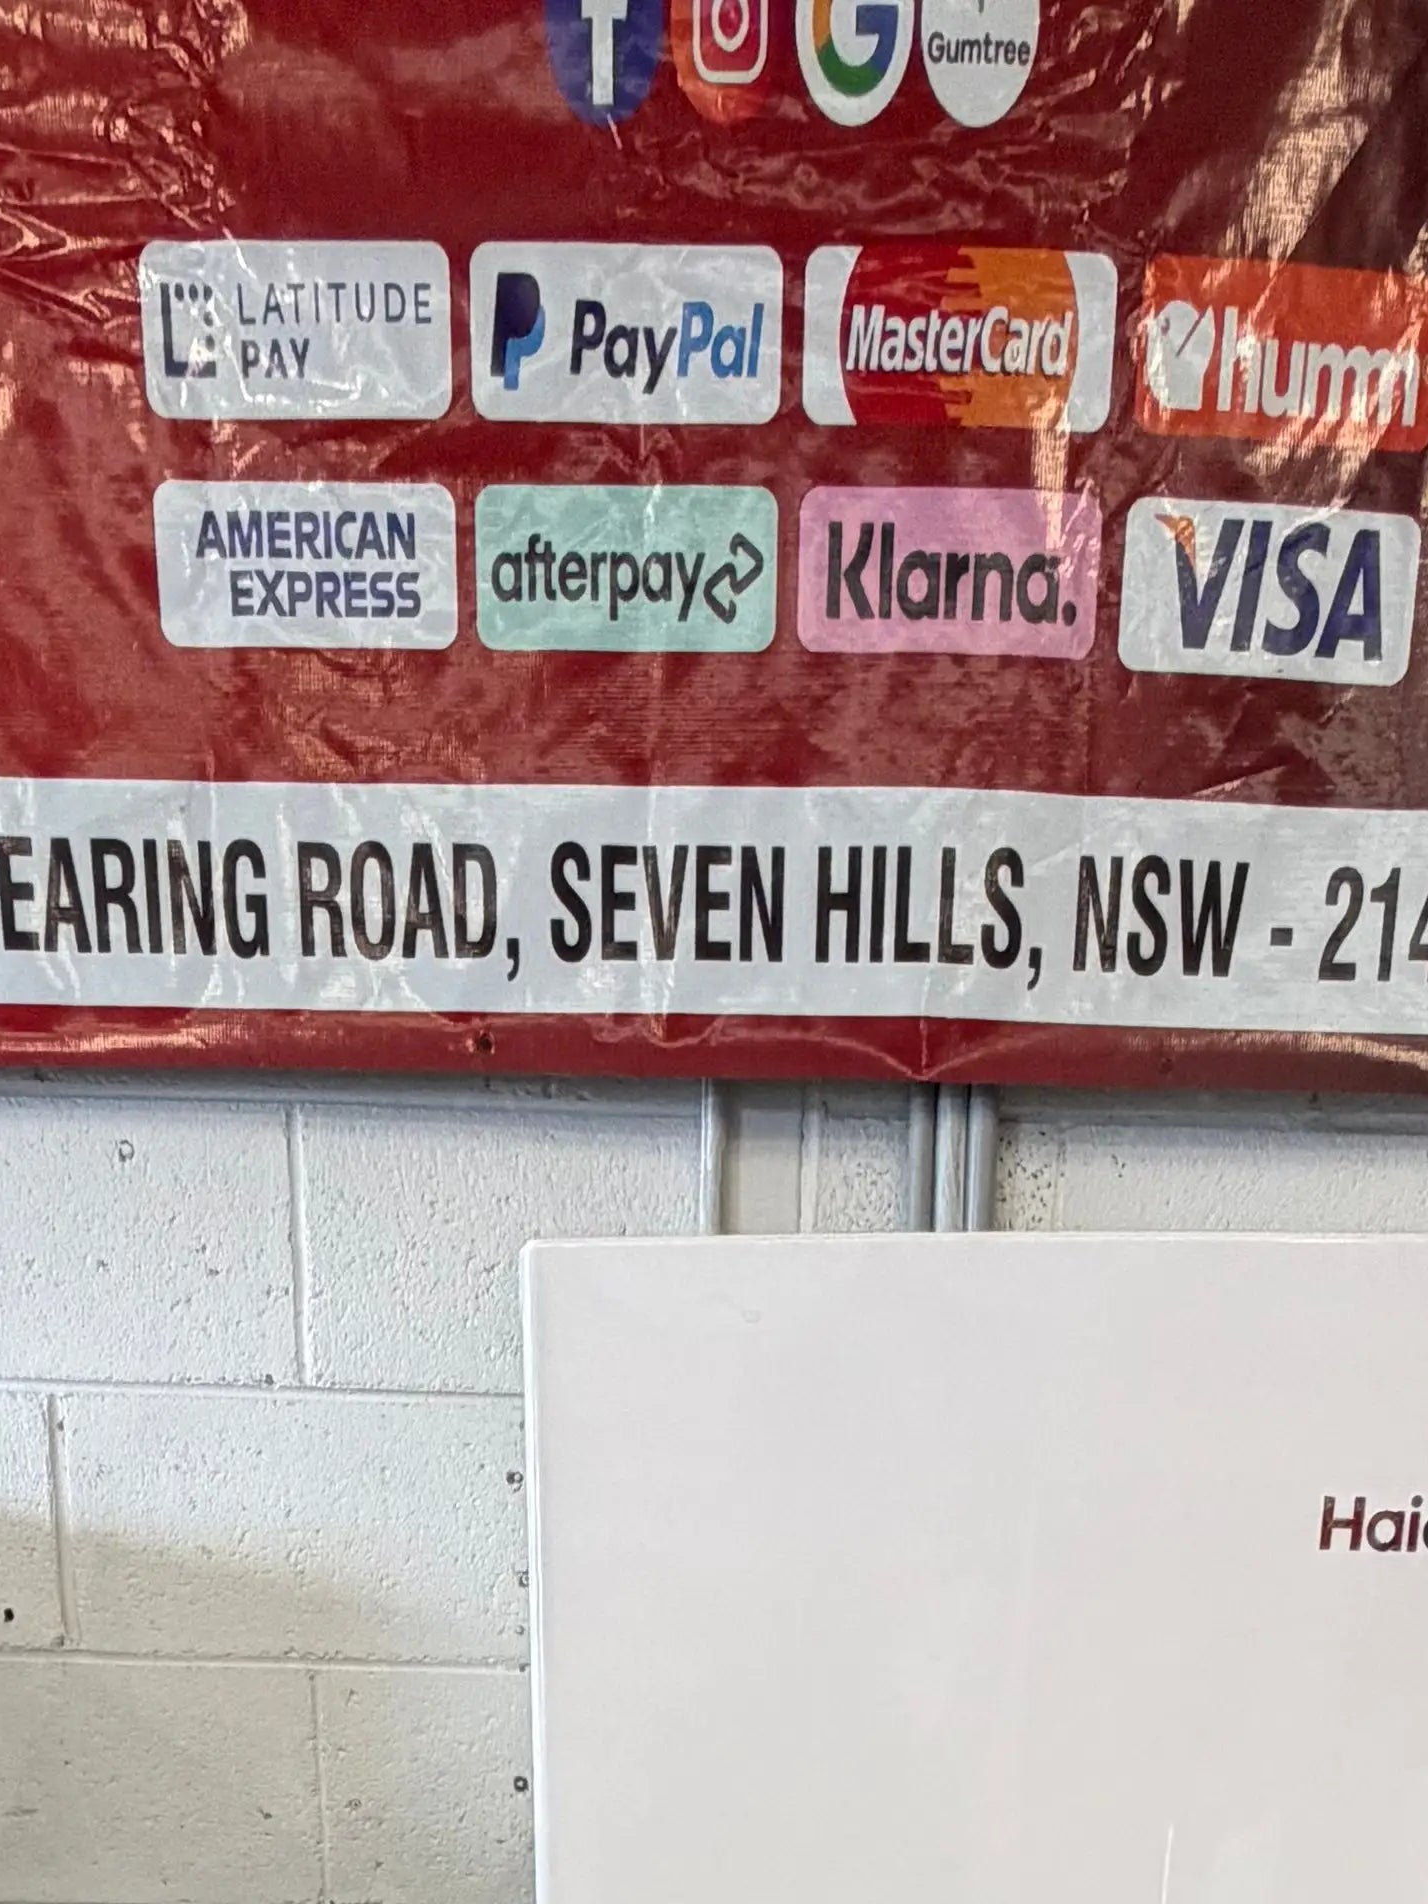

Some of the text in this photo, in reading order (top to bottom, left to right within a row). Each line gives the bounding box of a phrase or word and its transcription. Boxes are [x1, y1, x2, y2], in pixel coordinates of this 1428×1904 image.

[927, 31, 1031, 65] Gumtree
[236, 279, 433, 326] LATITUDE
[843, 302, 1073, 376] MasterCard
[241, 337, 310, 379] PAY
[572, 299, 761, 394] PayPal
[1216, 304, 1420, 428] humm
[195, 510, 417, 560] AMERICAN
[230, 569, 422, 618] EXPRESS
[491, 532, 704, 616] afterpay
[1156, 514, 1383, 661] VISA
[299, 842, 522, 982] ROAD,
[549, 842, 785, 963] SEVEN
[815, 845, 1043, 990] HILLS,
[1071, 854, 1251, 979] NSW
